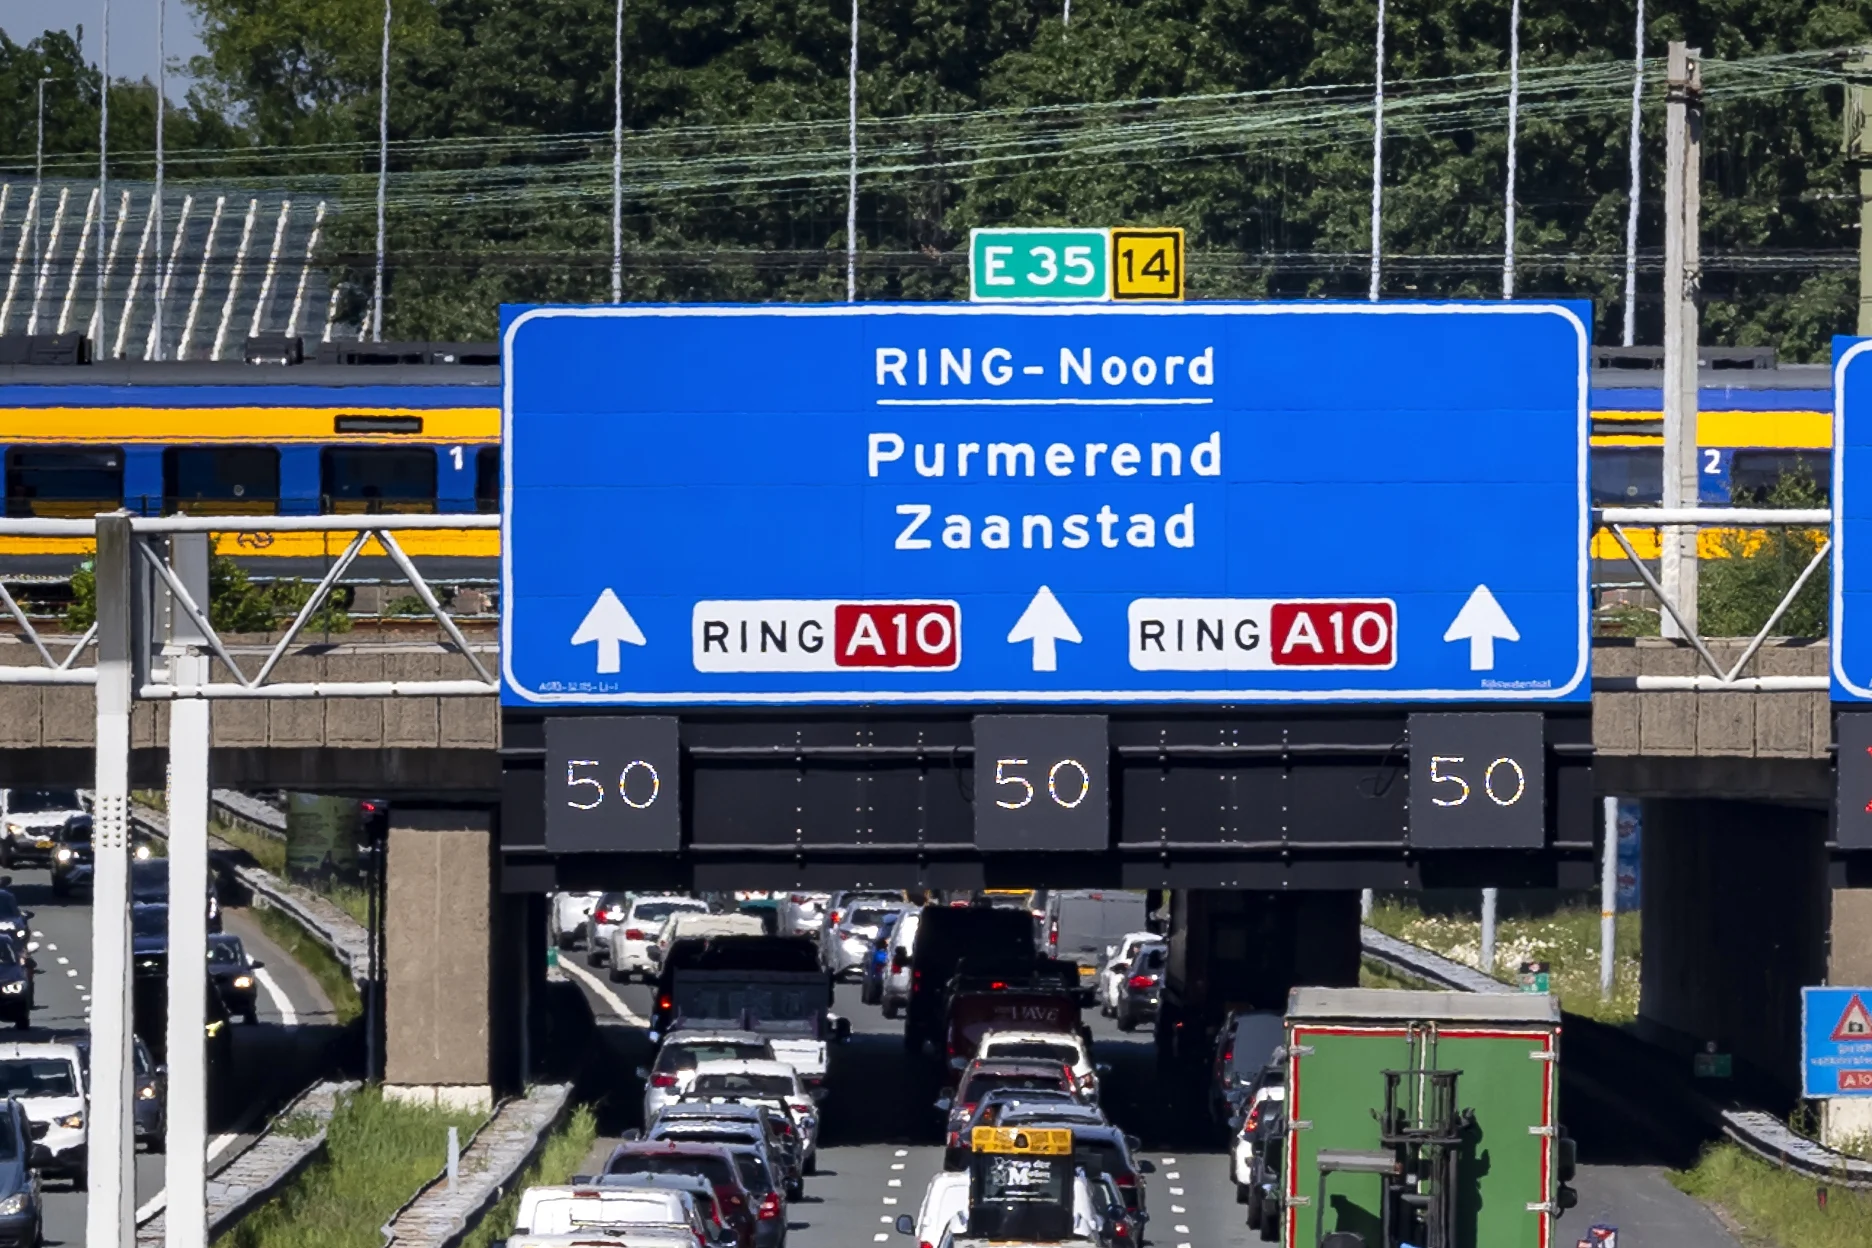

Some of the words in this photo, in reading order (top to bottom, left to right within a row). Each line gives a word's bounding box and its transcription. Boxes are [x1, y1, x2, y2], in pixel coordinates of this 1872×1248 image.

[1123, 247, 1172, 284] 14
[876, 346, 1216, 388] RING-Noord
[448, 446, 464, 471] 1
[868, 432, 1223, 478] Purmerend
[1703, 448, 1722, 474] 2
[895, 502, 1197, 552] Zaanstad
[703, 619, 825, 655] RING
[846, 611, 954, 657] A10
[1139, 618, 1261, 654] RING
[1273, 610, 1390, 656] A10
[568, 760, 661, 812] 50
[996, 760, 1091, 812] 50
[1431, 757, 1526, 810] 50
